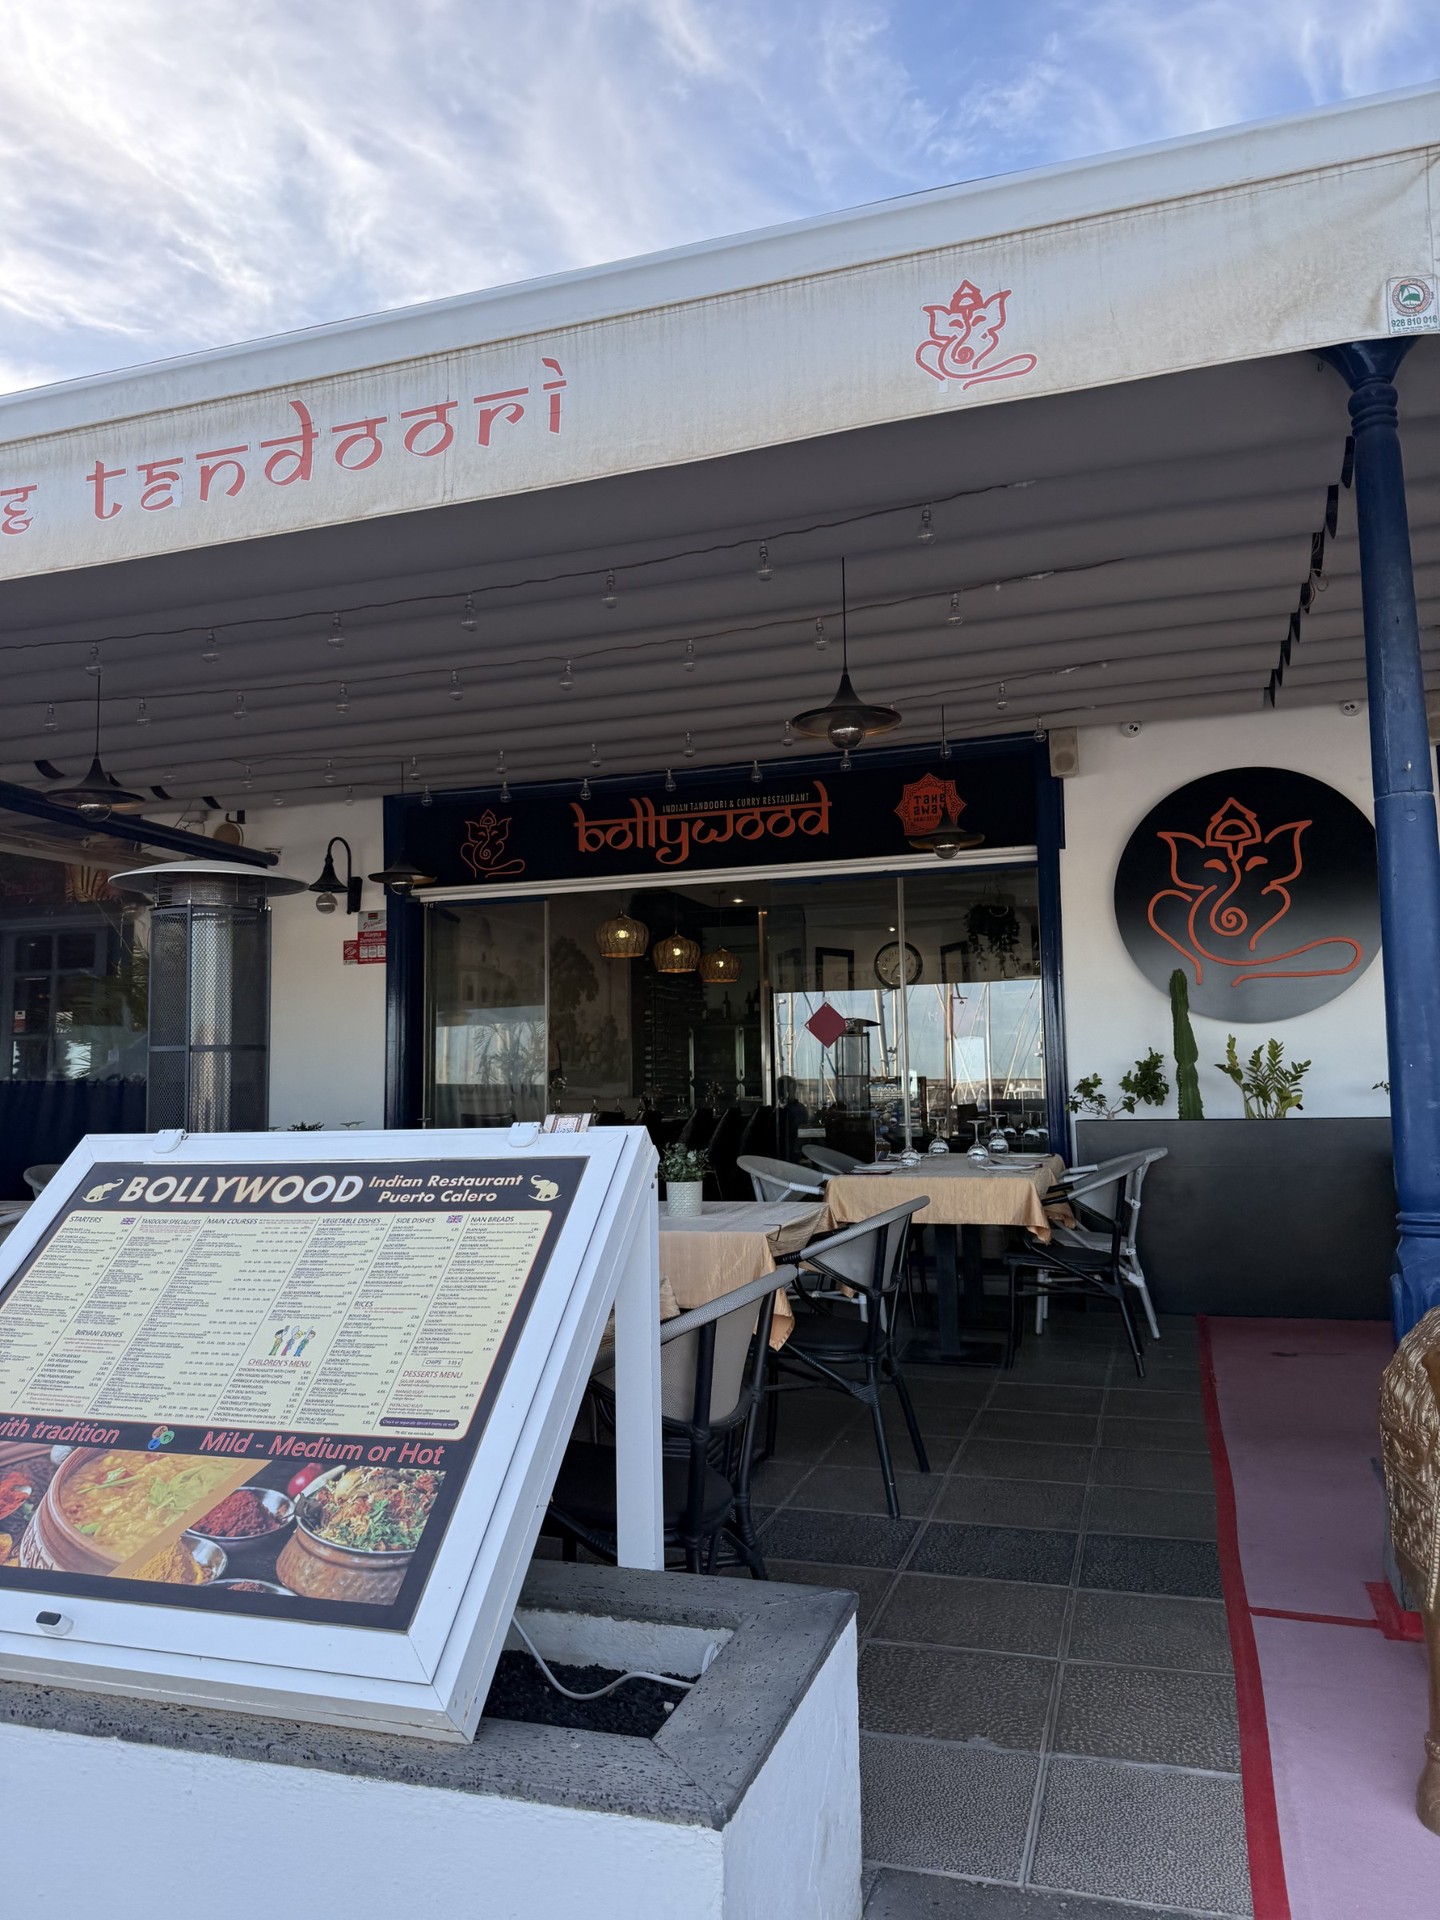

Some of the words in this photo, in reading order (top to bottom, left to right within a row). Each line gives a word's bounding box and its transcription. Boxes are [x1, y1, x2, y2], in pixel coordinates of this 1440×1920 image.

[1391, 319, 1405, 327] 928
[1407, 317, 1421, 326] 810
[1423, 315, 1438, 323] 016
[662, 802, 688, 813] INDIAN
[690, 800, 728, 811] TANDOORI
[729, 799, 734, 808] &
[737, 797, 761, 808] CURRY
[763, 792, 810, 805] RESTAURANT
[570, 780, 832, 864] bollywood
[118, 1175, 364, 1203] BOLLYWOOD
[368, 1175, 423, 1188] Indian
[427, 1174, 523, 1187] Restaurant
[377, 1191, 435, 1203] Puerto
[440, 1190, 498, 1203] Calero
[75, 1329, 100, 1337] BIRYANI
[100, 1330, 124, 1338] DISHES
[248, 1359, 288, 1367] CHILDREN'S
[402, 1370, 438, 1378] DESSERTS
[439, 1371, 463, 1379] MENU
[31, 1420, 121, 1444] tradition
[199, 1430, 254, 1453] Mild
[268, 1435, 361, 1461] Medium
[367, 1445, 397, 1463] or
[397, 1442, 446, 1465] Hot
